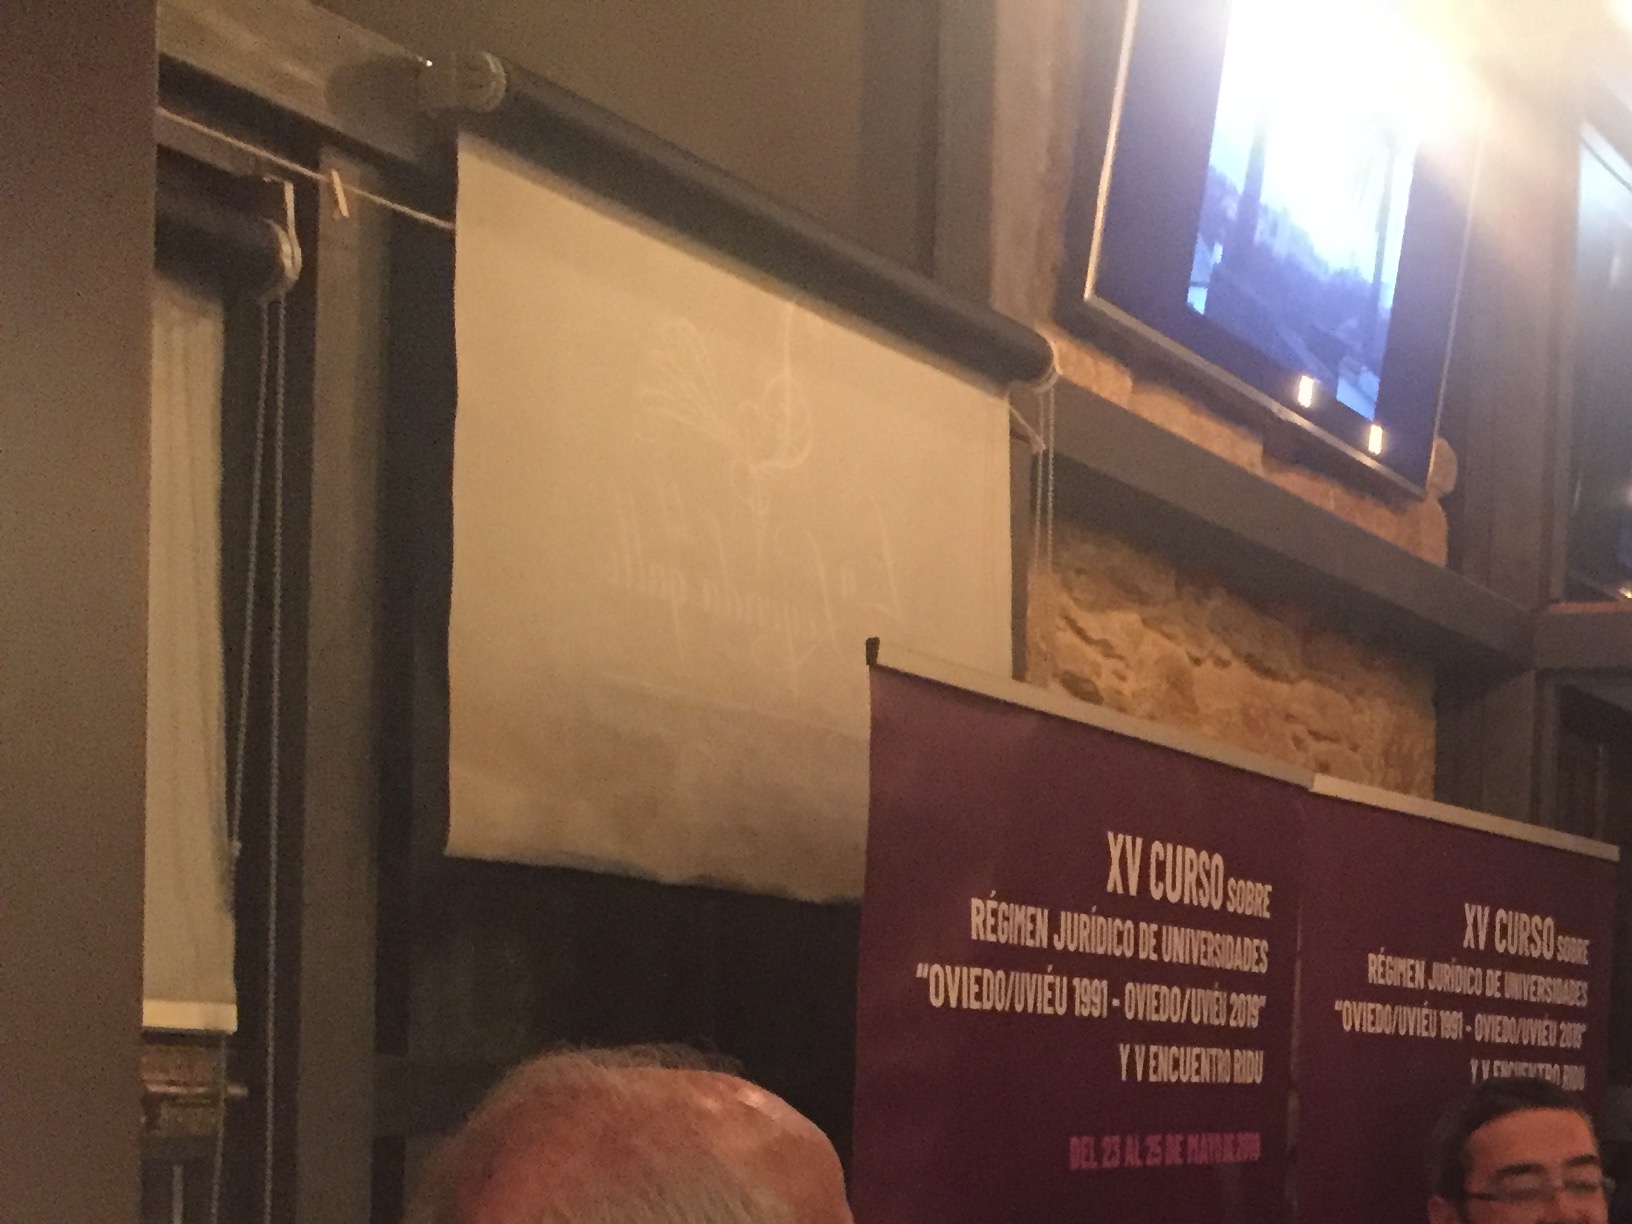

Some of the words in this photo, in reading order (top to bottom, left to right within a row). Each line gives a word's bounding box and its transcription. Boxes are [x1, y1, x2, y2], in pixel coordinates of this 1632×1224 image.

[1106, 830, 1143, 897] XV
[1149, 840, 1225, 911] CURSO
[1226, 876, 1273, 919] SOBRE
[970, 889, 1049, 949] RÉGIMEN
[1053, 905, 1135, 959] JURÍDICO
[1138, 921, 1159, 961] DE
[1161, 924, 1269, 974] UNIVERSIDADES
[1463, 902, 1490, 951] XV
[1494, 908, 1555, 960] CURSO
[1556, 934, 1590, 966] SOBRE
[916, 962, 1068, 1016] "OVIEDO/UVIÉU
[1072, 976, 1108, 1019] 1991
[1124, 981, 1228, 1027] OVIEDO/UVIÉU
[1367, 946, 1425, 990] RÉGIMEN
[1427, 957, 1483, 997] JURÍDICO
[1485, 968, 1502, 999] DE
[1504, 970, 1589, 1008] UNIVERSIDADES
[1440, 1010, 1463, 1040] 1991
[1119, 1042, 1131, 1082] Y
[1134, 1042, 1146, 1082] V
[1149, 1044, 1231, 1083] ENCUENTRO
[1470, 1058, 1479, 1085] Y
